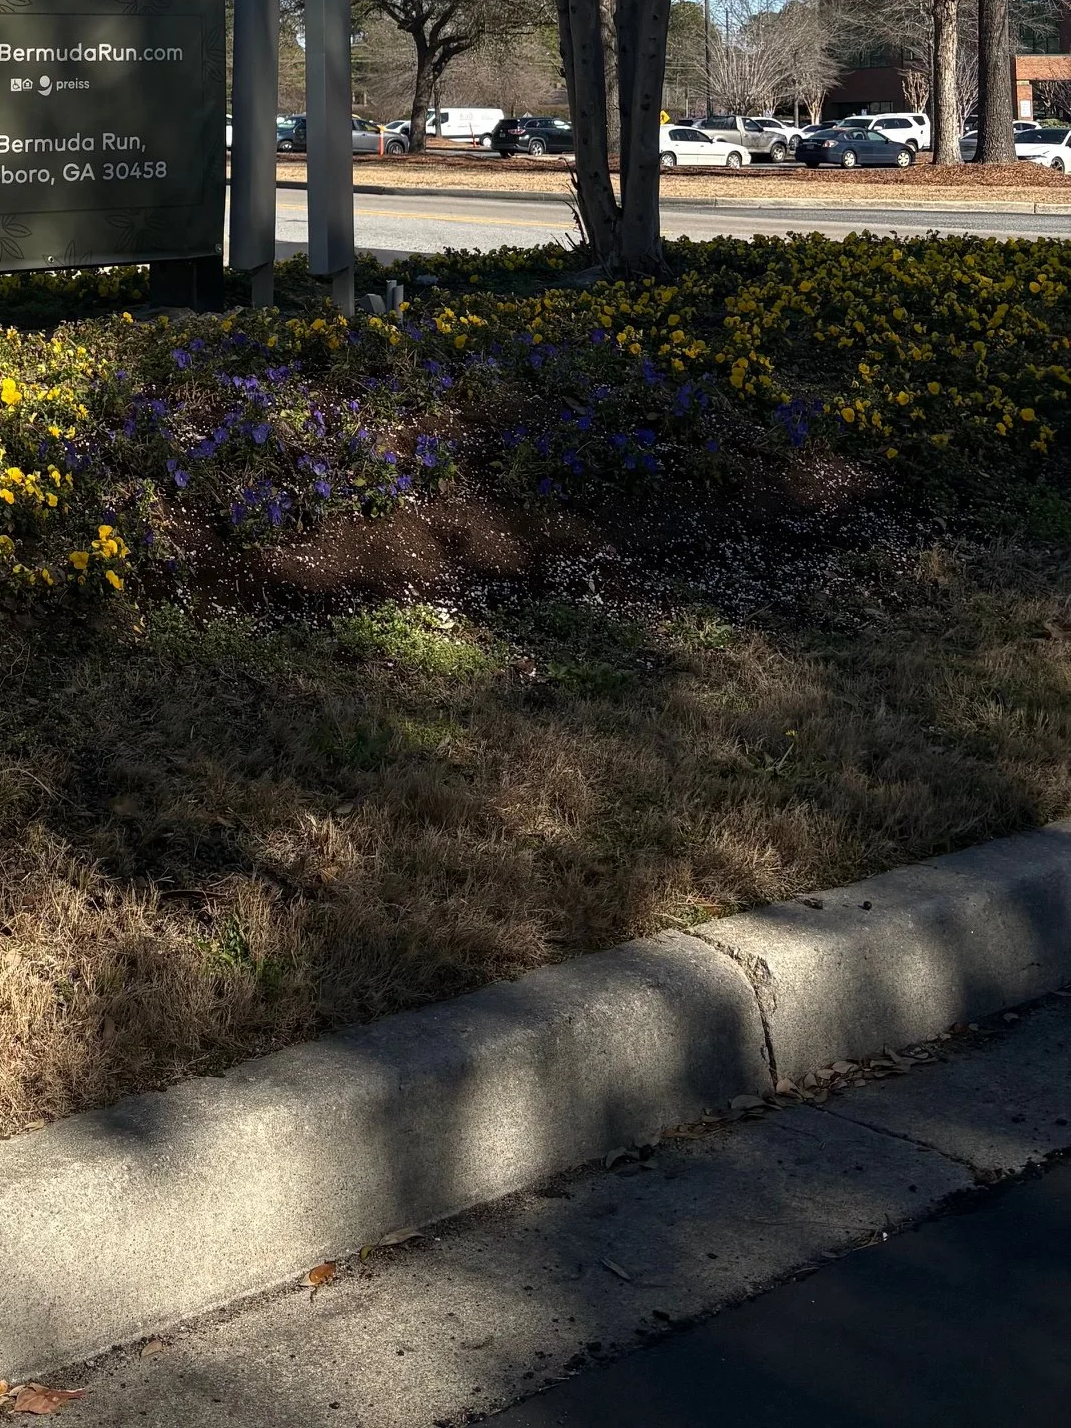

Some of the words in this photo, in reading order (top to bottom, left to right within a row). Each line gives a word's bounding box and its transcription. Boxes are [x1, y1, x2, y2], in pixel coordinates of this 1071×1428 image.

[56, 77, 90, 91] preiss
[102, 132, 147, 153] Run,
[62, 161, 97, 182] GA
[102, 160, 168, 181] 30458
